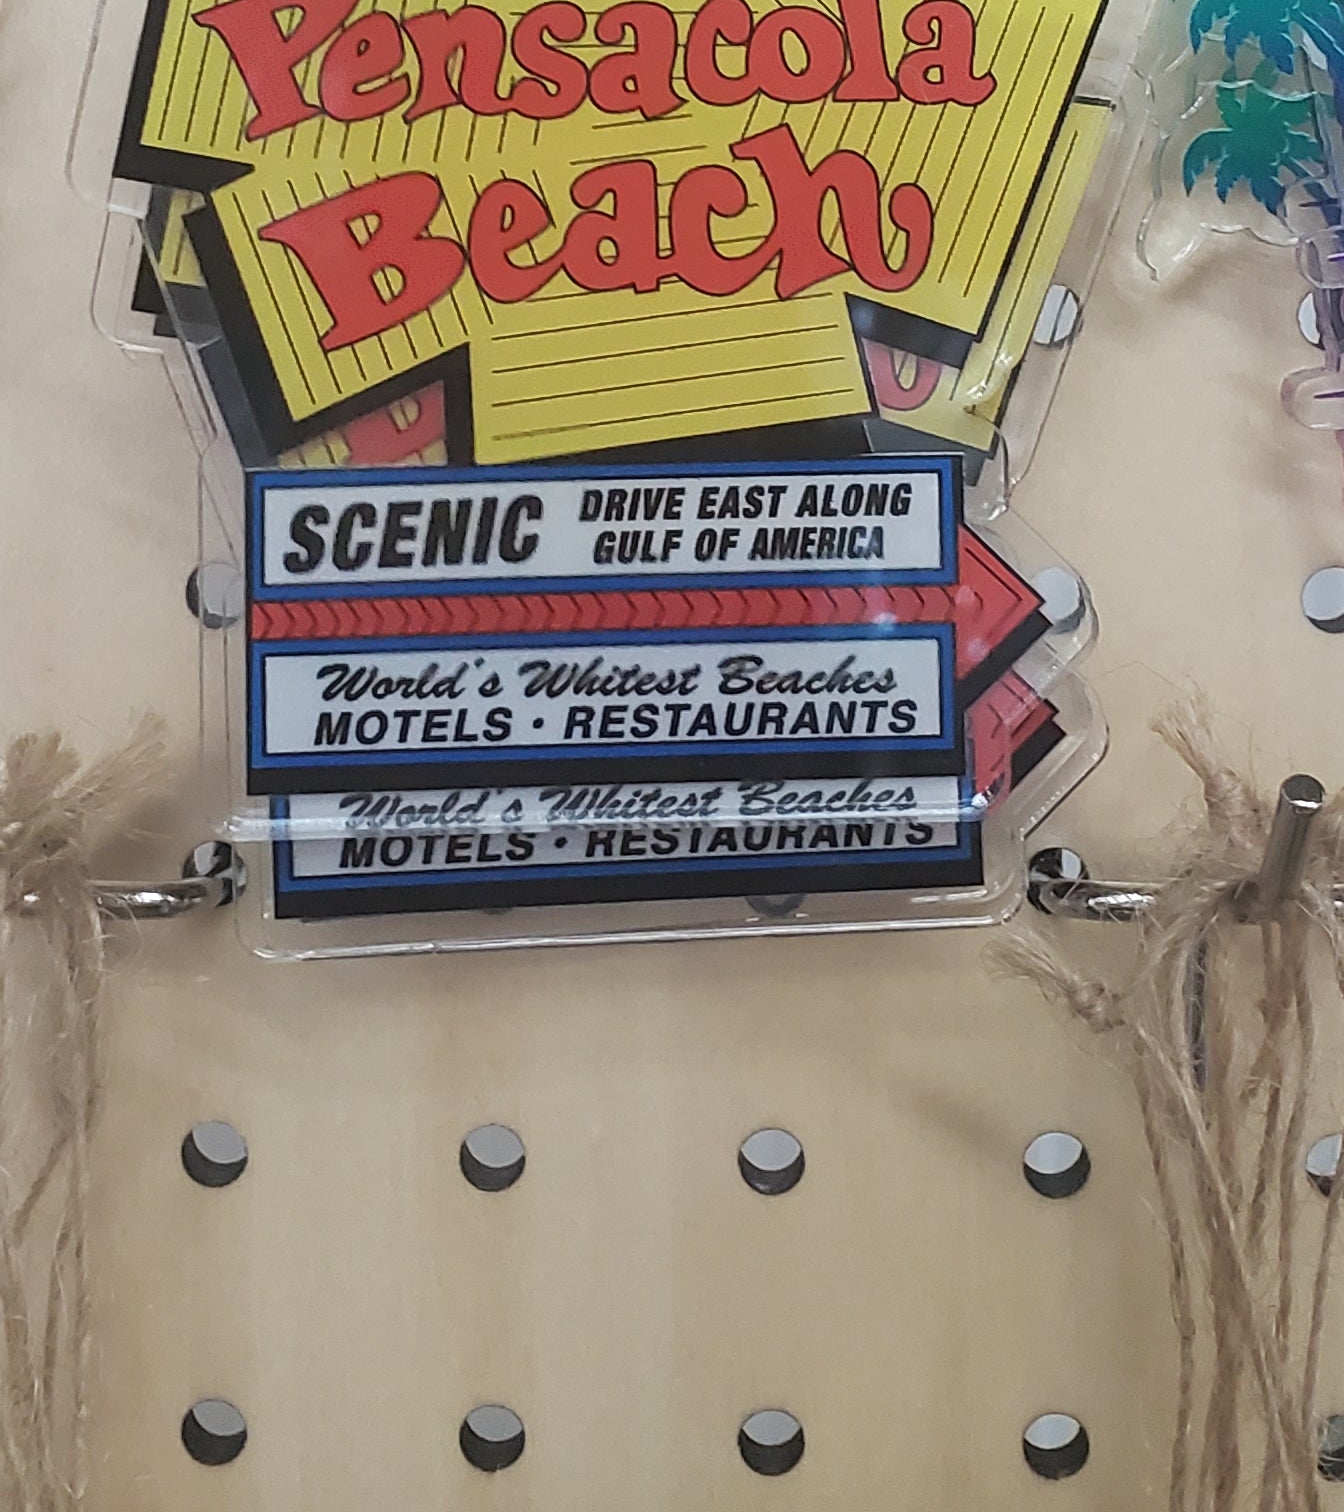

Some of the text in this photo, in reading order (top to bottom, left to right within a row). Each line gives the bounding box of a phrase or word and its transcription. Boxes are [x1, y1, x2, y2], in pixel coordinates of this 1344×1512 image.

[260, 123, 936, 350] Beach
[579, 482, 913, 522] DRIVE EAST ALONG
[283, 494, 544, 575] SCENIC
[593, 524, 886, 565] GULF OF AMERICA
[315, 653, 899, 702] World's Whitest Beaches
[313, 699, 919, 746] MOTELS RESTAURANTS
[339, 833, 536, 869] MOTELS
